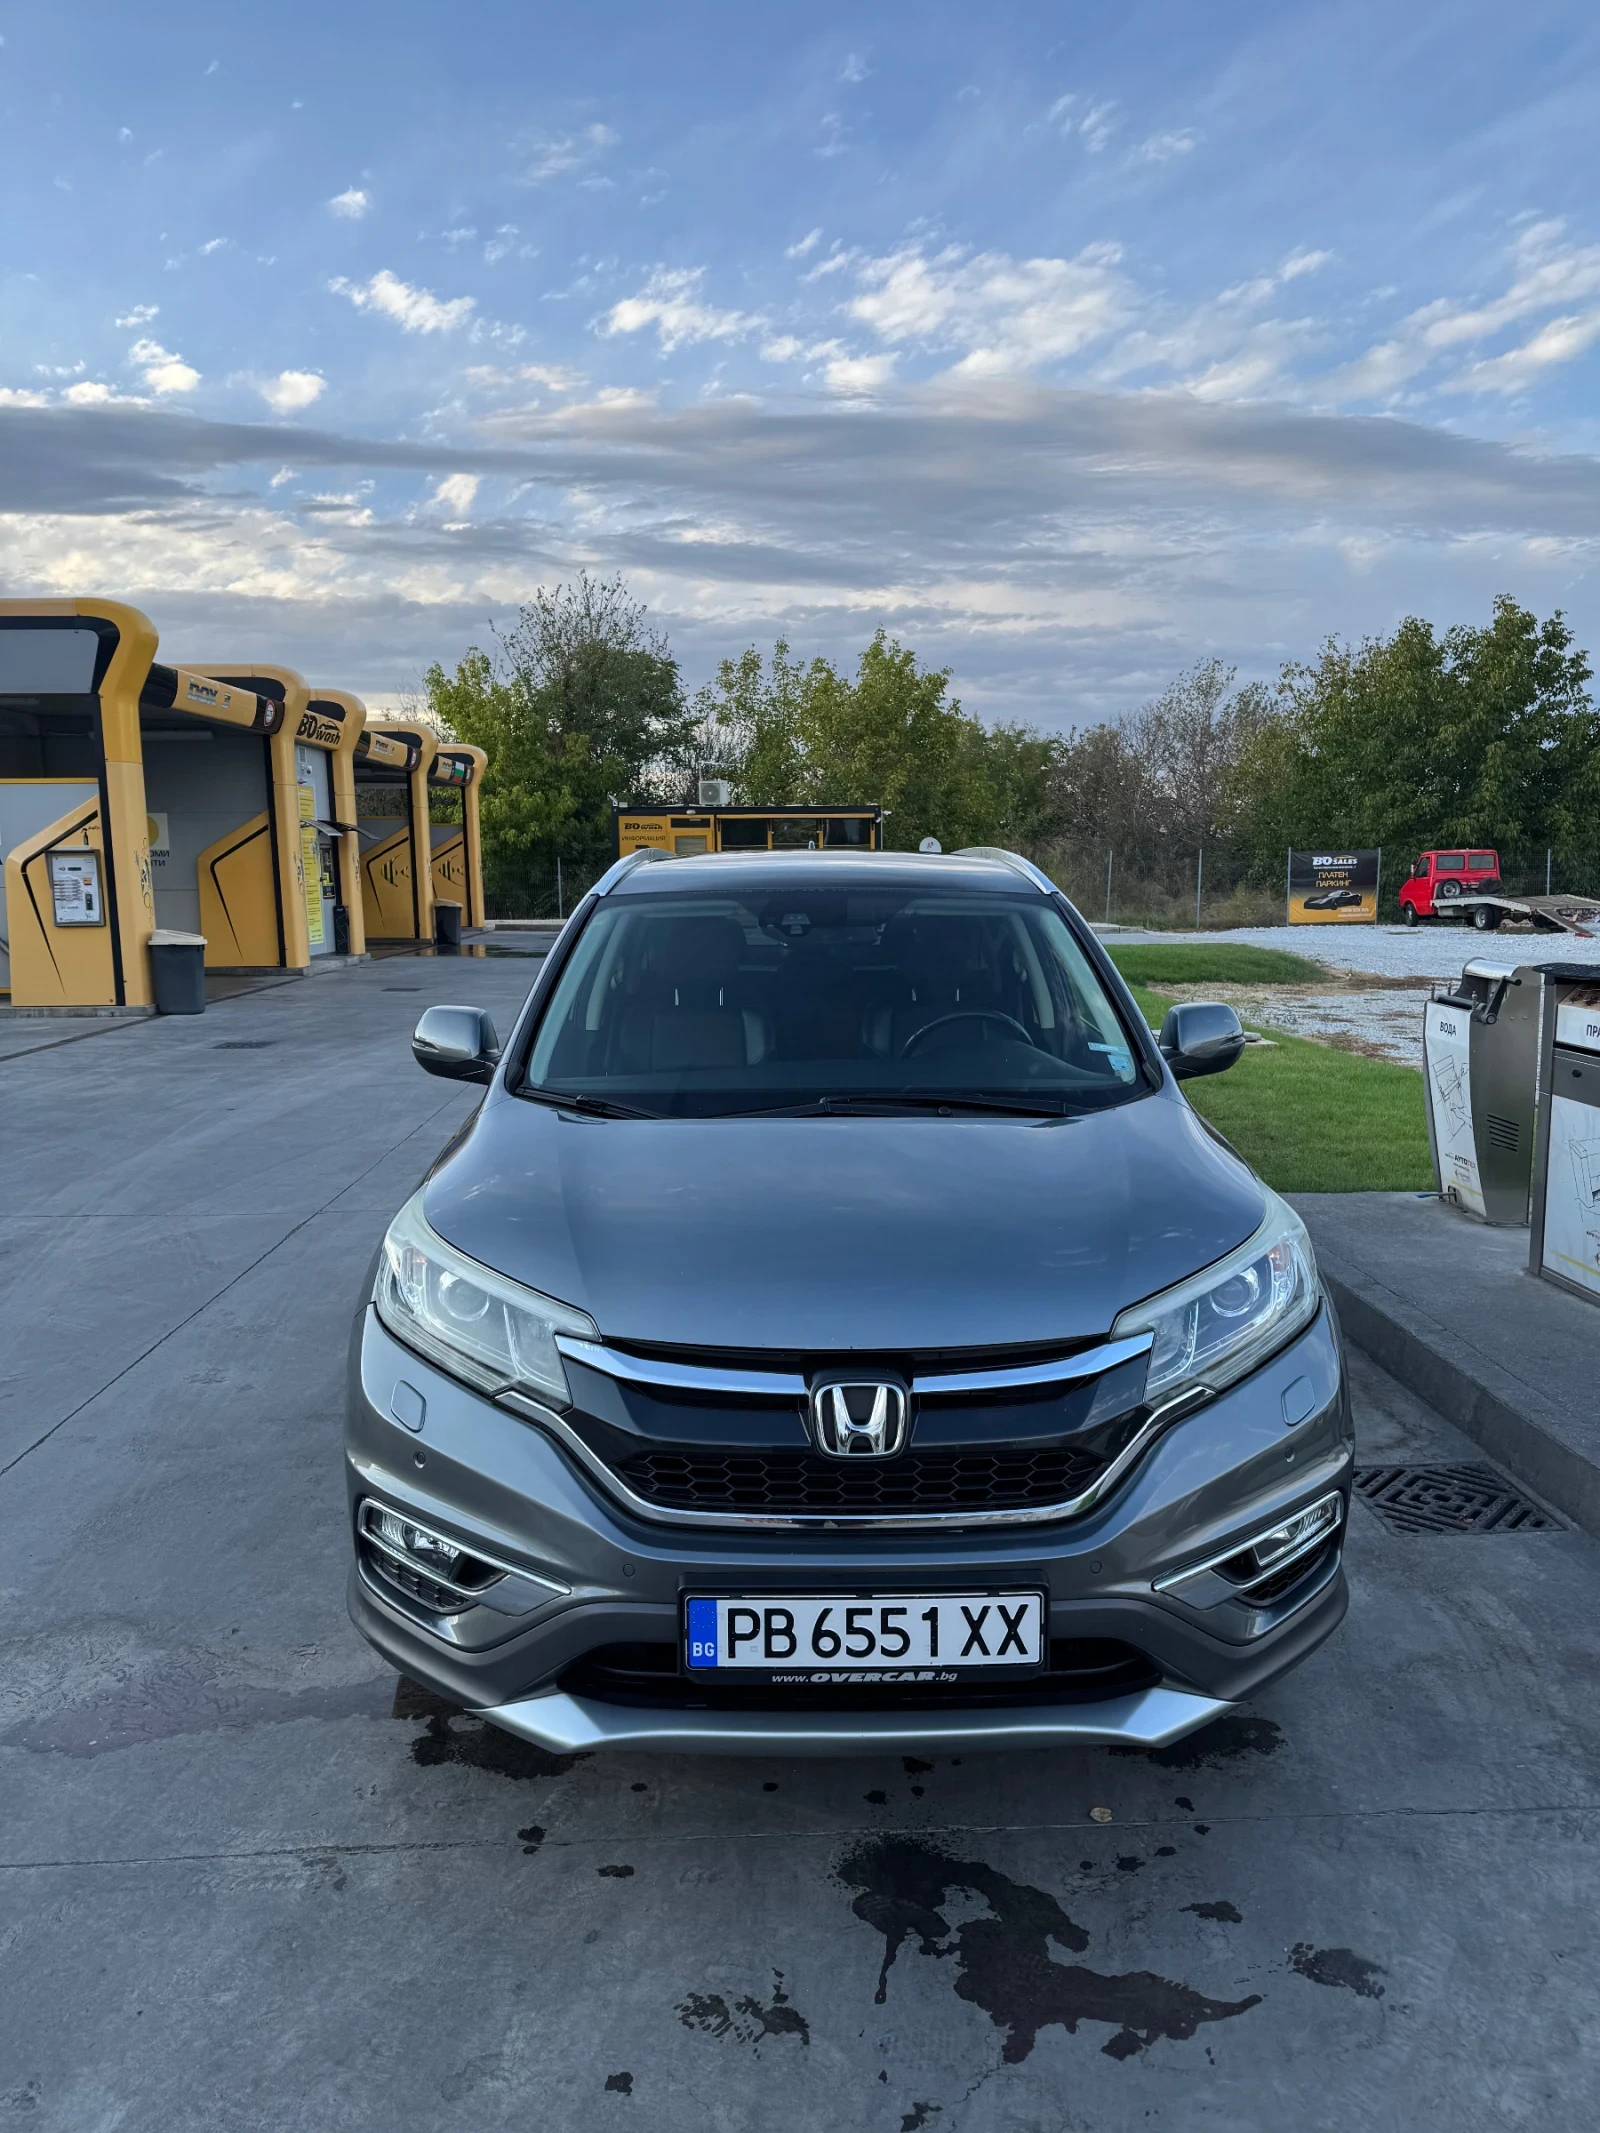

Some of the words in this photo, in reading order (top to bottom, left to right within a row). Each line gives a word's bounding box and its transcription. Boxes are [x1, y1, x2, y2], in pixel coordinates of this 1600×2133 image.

[315, 728, 341, 745] wash
[1312, 856, 1333, 866] BO
[1318, 871, 1349, 879] ПЛАТЕН
[1315, 879, 1352, 888] ПАРКИНГ
[1440, 1021, 1457, 1036] ВОДА
[726, 1606, 798, 1659] PB
[811, 1606, 940, 1659] 6551
[959, 1603, 1030, 1657] XX
[692, 1641, 715, 1658] BG
